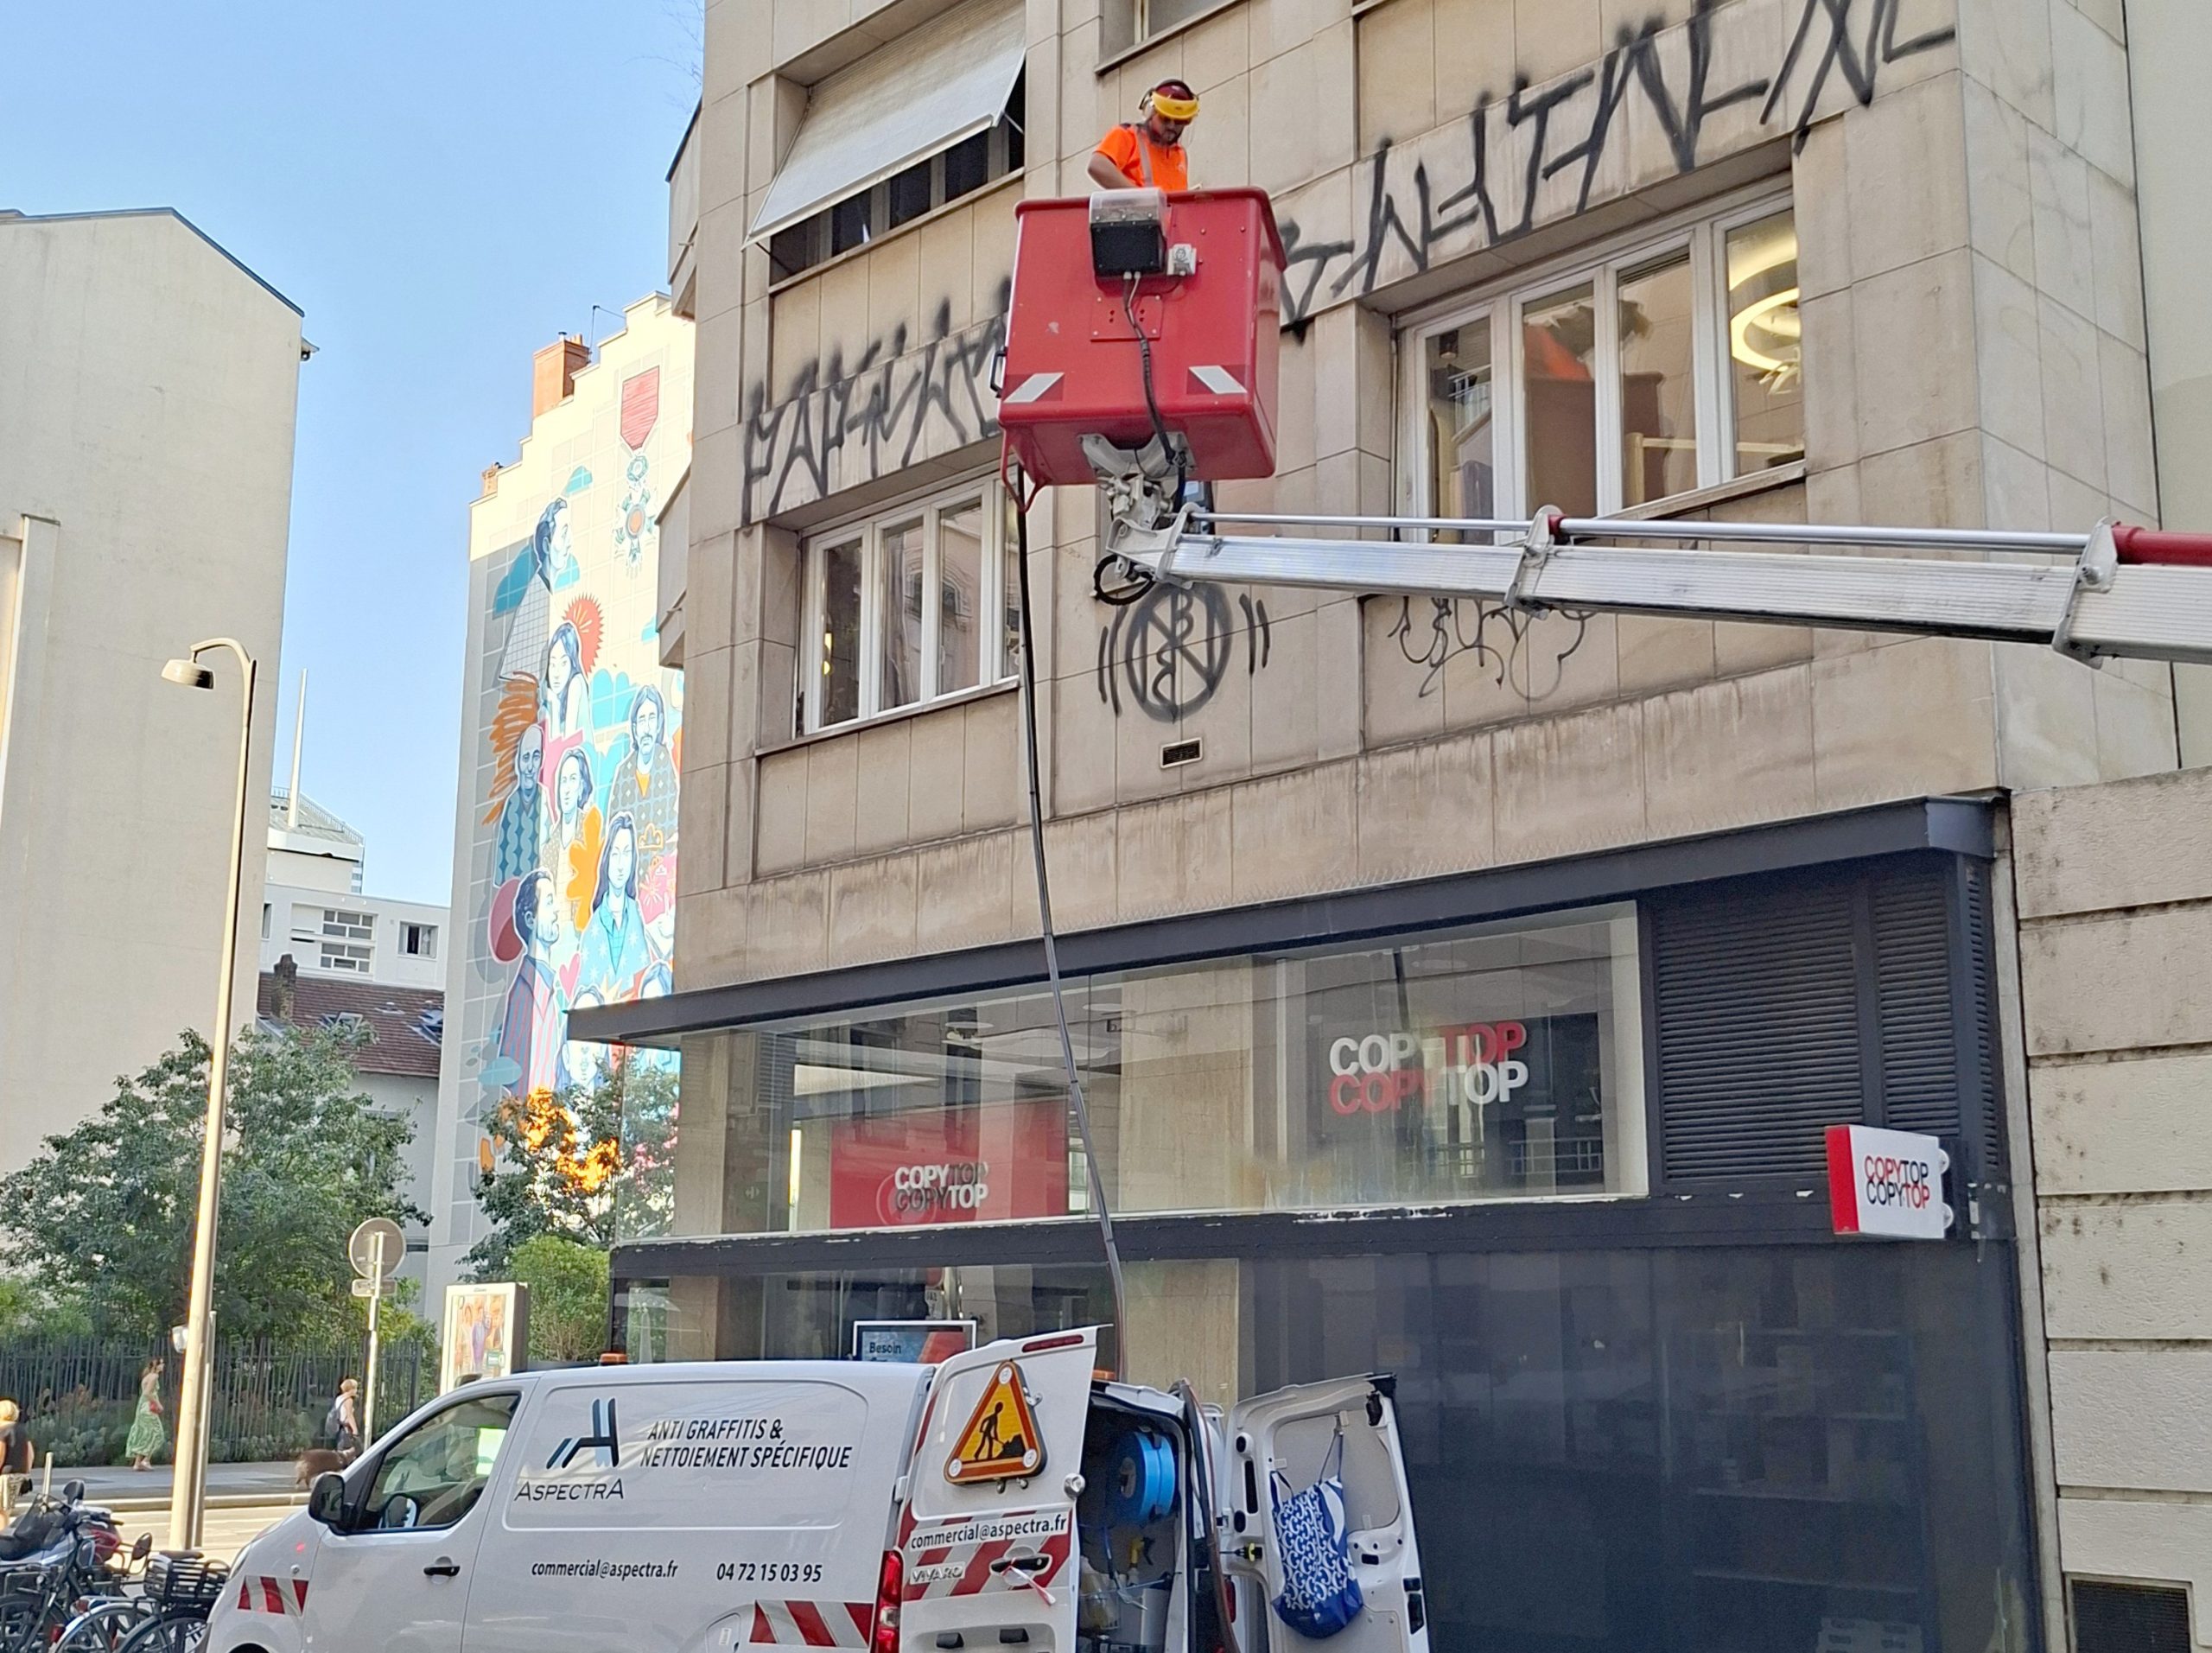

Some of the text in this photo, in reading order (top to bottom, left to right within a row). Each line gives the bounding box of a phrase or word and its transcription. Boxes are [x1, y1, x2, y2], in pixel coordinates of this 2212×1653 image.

[1329, 1020, 1527, 1077] COPTOP
[894, 1161, 989, 1190] COPYTOP
[1865, 1155, 1929, 1186] COPYTOP
[896, 1184, 989, 1211] COPYTOP
[1866, 1179, 1930, 1209] COPYTOP
[869, 1342, 901, 1354] Besoin
[647, 1419, 784, 1440] ANTI GRAFFITIS &
[639, 1440, 853, 1470] NETTOIEMENT SPÉCIFIQUE
[911, 1513, 1067, 1549] commercial@aspectra.fr
[531, 1559, 678, 1581] commercial@aspectra.fr
[912, 1567, 963, 1583] VIVARO
